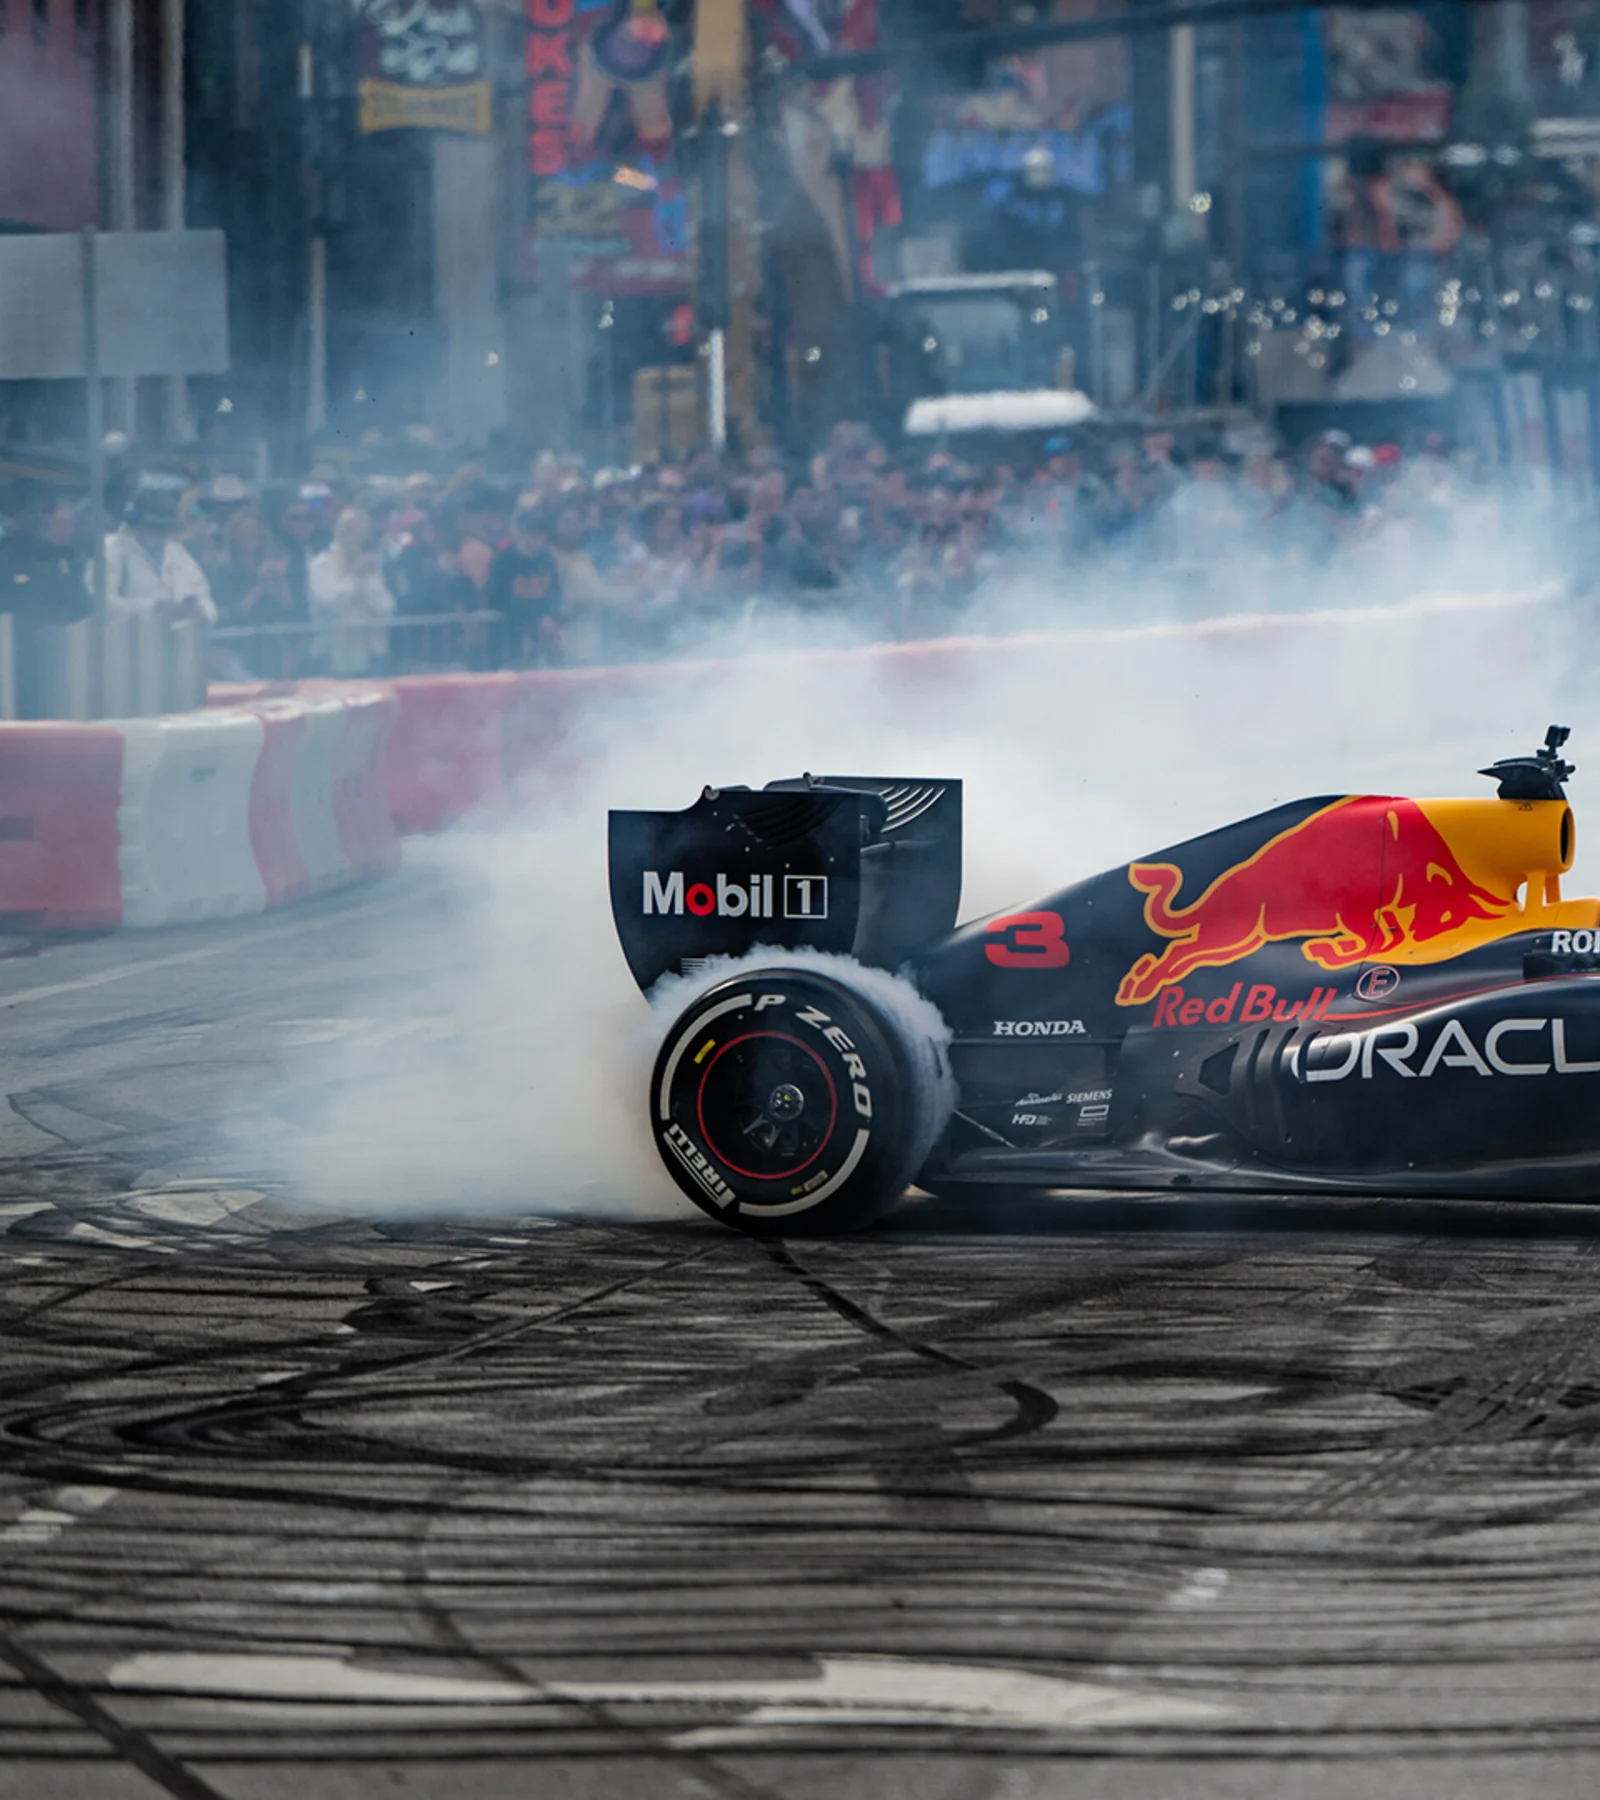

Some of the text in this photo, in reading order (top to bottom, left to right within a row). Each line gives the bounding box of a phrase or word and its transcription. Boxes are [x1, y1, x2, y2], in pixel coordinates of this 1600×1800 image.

[643, 871, 773, 917] Mobil
[984, 910, 1071, 969] 3
[993, 1020, 1087, 1036] HONDA
[1152, 982, 1338, 1028] Red Bull
[795, 1005, 873, 1118] ZERO
[1066, 1088, 1113, 1104] SIEMENS
[663, 1123, 736, 1210] PIRELLI
